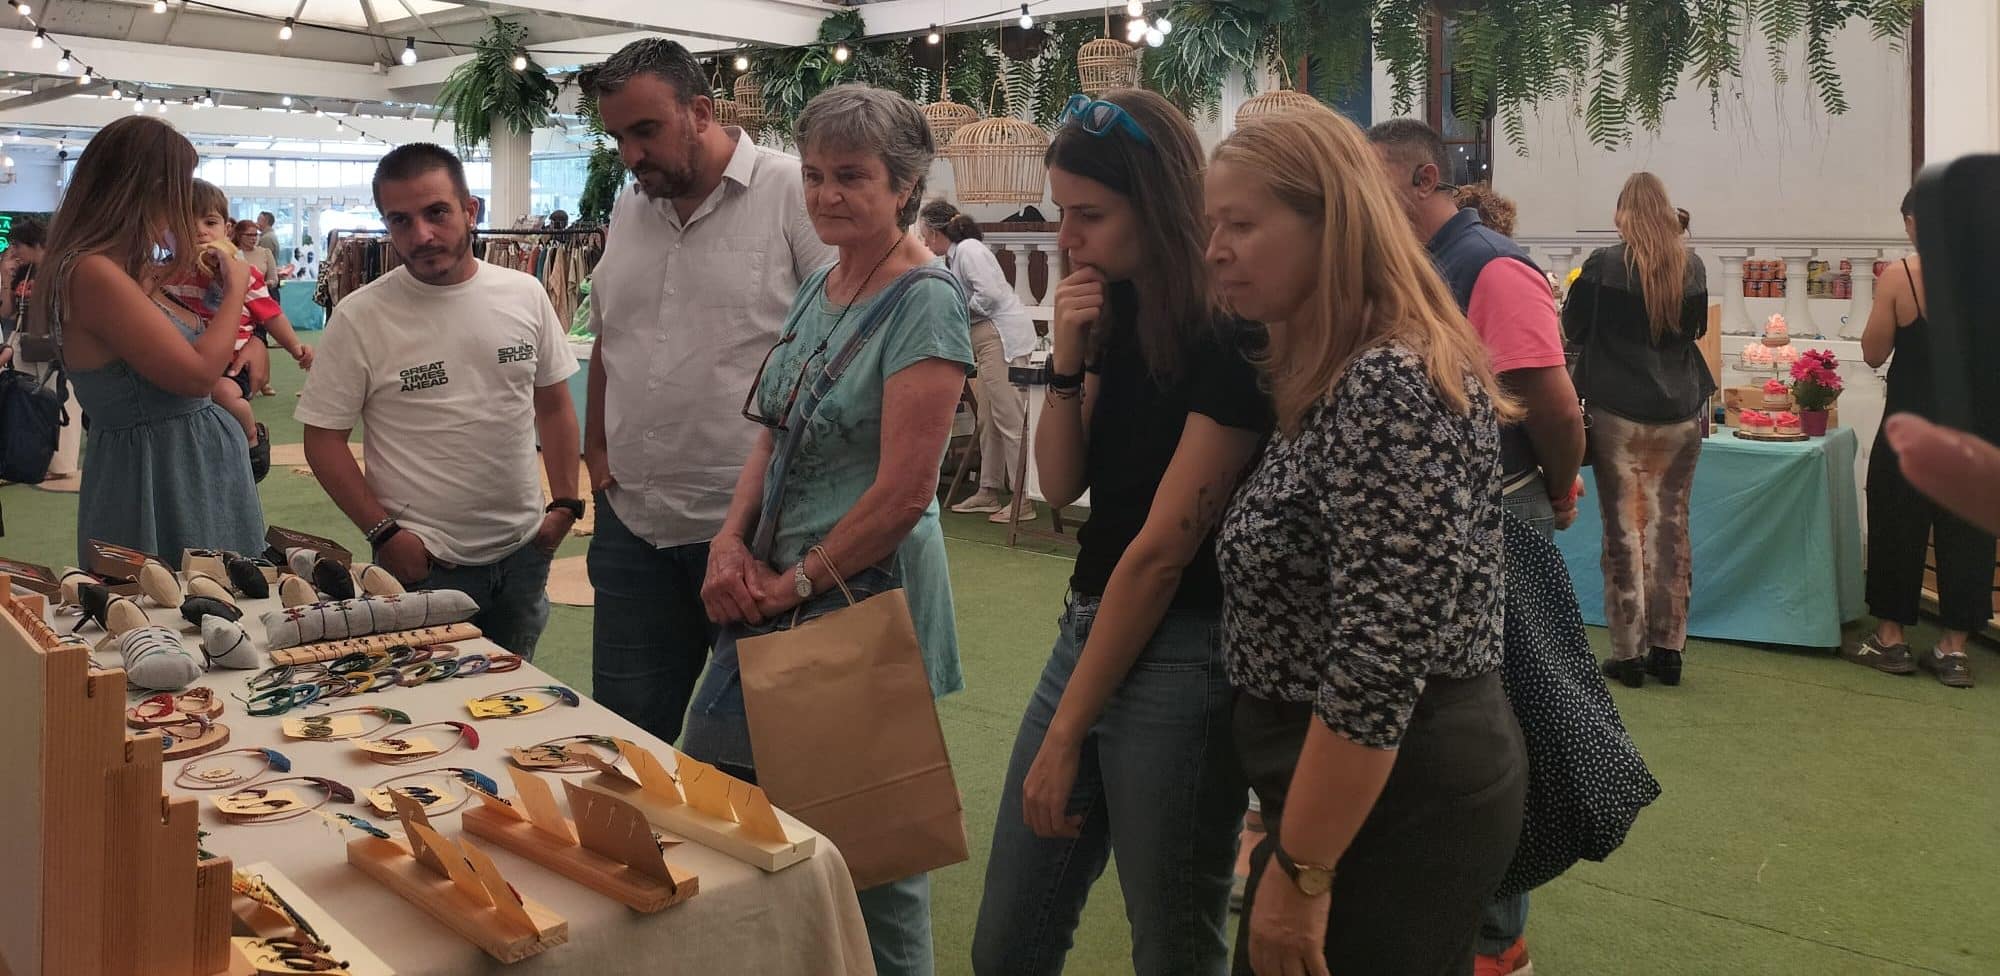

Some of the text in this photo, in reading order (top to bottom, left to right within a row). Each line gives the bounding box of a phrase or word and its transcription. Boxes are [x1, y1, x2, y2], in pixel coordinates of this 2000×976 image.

[498, 345, 533, 356] SOUND
[400, 361, 444, 377] GREAT
[400, 369, 446, 384] TIMES
[400, 377, 448, 392] AHEAD
